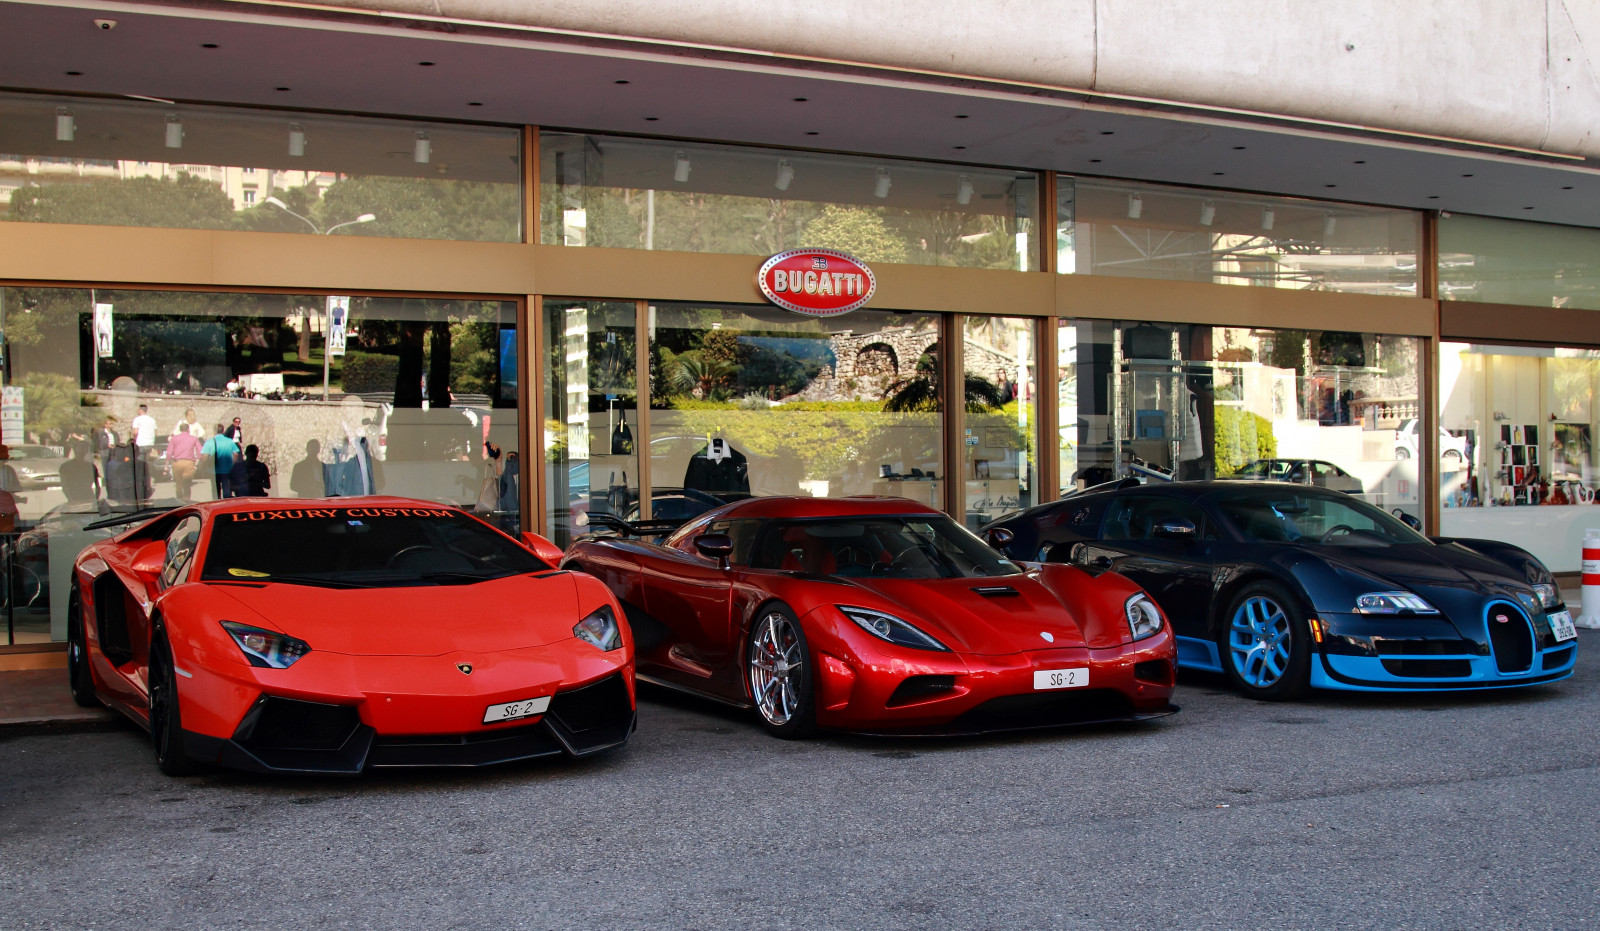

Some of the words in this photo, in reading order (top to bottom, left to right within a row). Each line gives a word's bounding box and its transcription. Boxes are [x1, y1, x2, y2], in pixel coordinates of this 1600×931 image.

[773, 269, 864, 297] BUGATTI
[232, 509, 338, 522] LUXURY
[346, 508, 455, 518] CUSTOM
